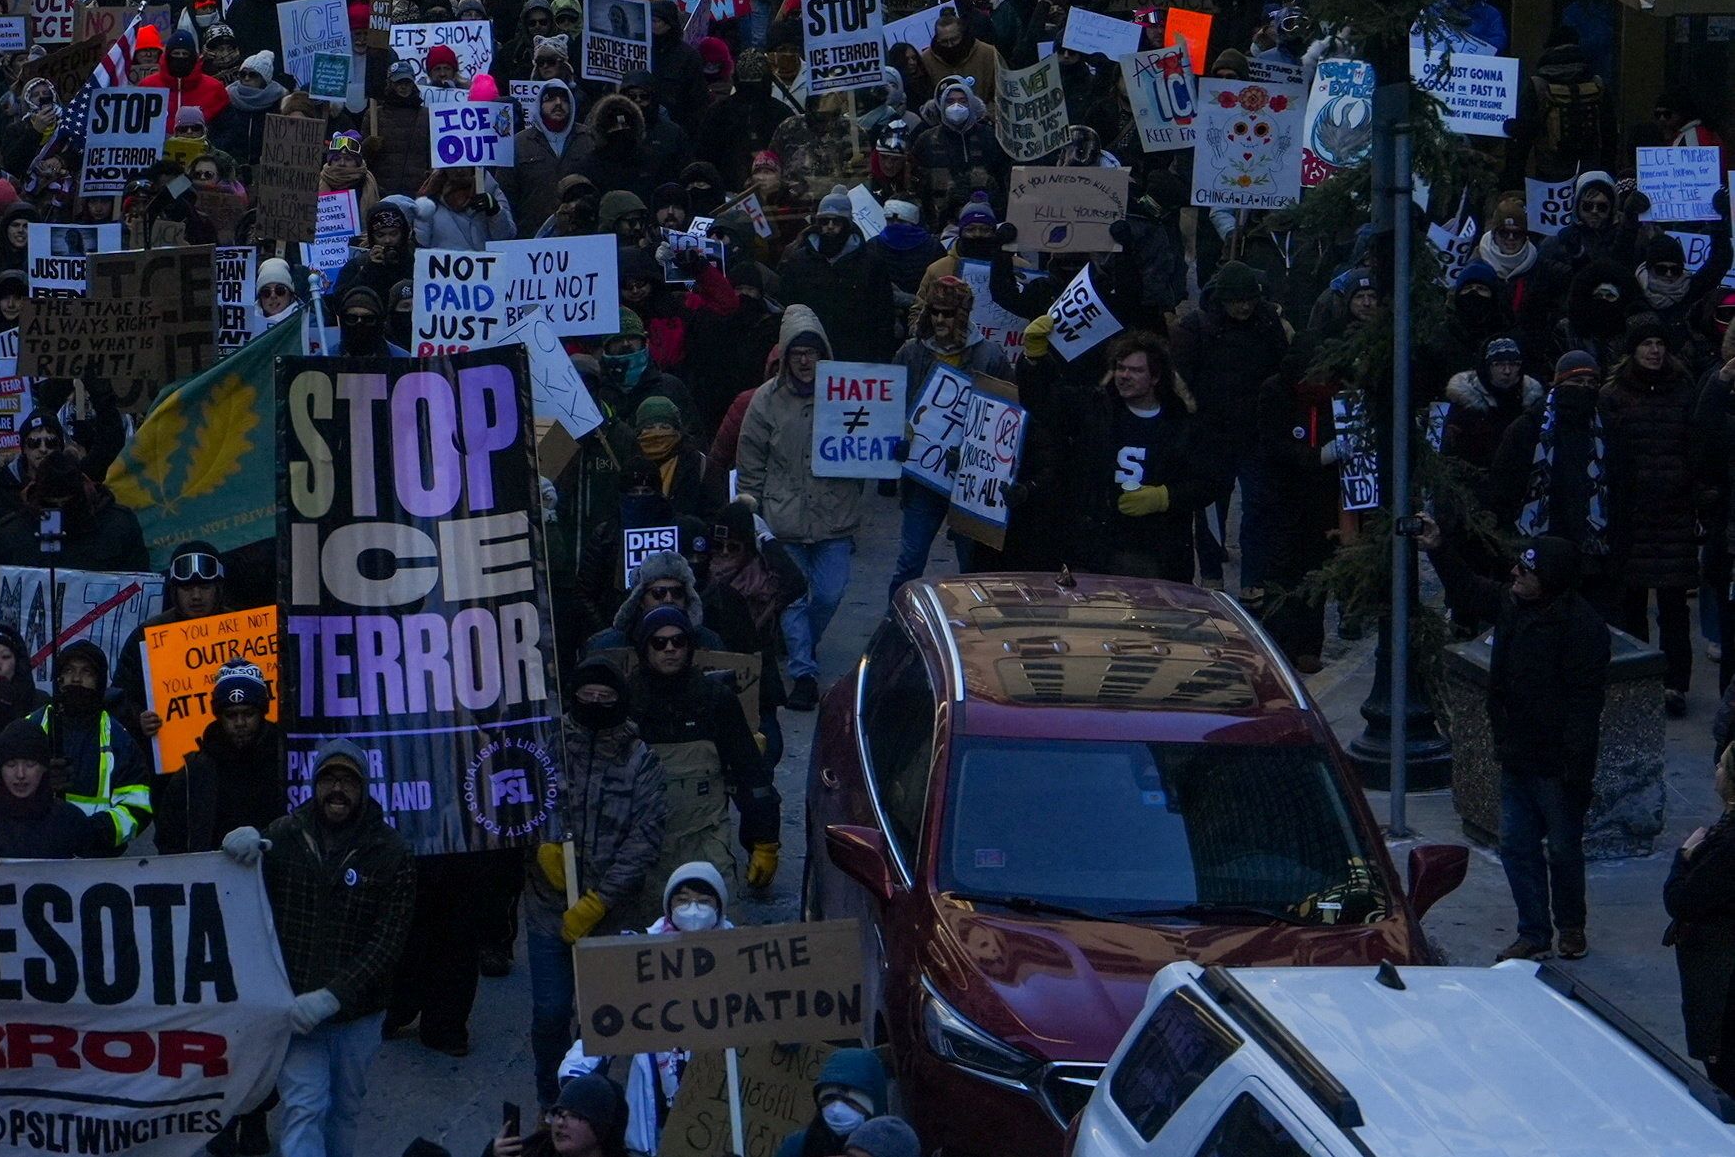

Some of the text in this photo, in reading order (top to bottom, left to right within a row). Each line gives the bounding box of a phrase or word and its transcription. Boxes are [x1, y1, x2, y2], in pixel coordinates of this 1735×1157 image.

[809, 44, 880, 65] ICE TERROR
[809, 60, 880, 81] NOW!
[436, 109, 490, 133] ICE
[438, 135, 497, 165] OUT
[430, 256, 494, 282] NOT
[424, 285, 493, 311] PAID
[420, 315, 497, 340] JUST
[827, 378, 892, 401] HATE
[289, 367, 517, 520] STOP
[290, 511, 535, 606] ICE
[288, 602, 548, 717] TERROR
[492, 769, 533, 805] PSL
[637, 936, 811, 983] END THE
[592, 983, 860, 1034] OCCUPATION
